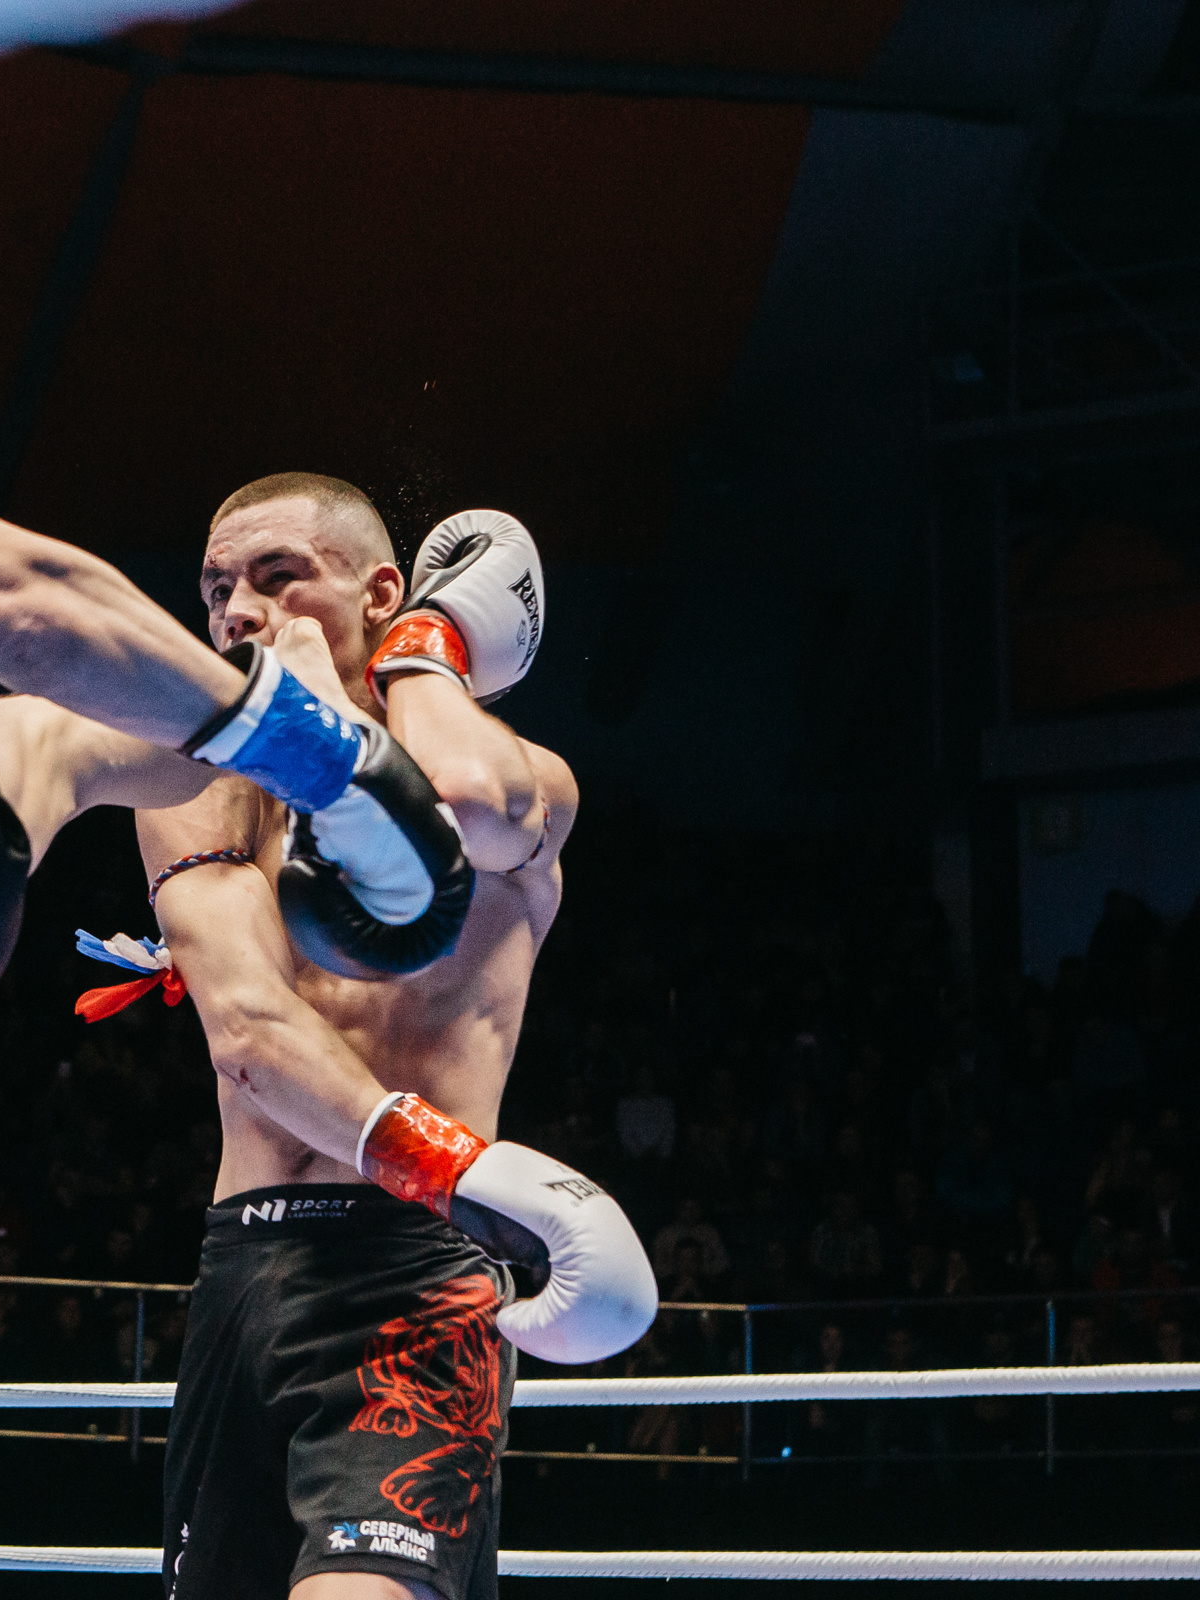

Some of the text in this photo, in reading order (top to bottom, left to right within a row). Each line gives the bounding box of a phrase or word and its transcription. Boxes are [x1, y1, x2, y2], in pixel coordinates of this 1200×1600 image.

[290, 1199, 356, 1212] SPORT
[359, 1520, 436, 1552] СЕВЕРНЫЙ
[368, 1535, 429, 1562] АЛЬЯНС
